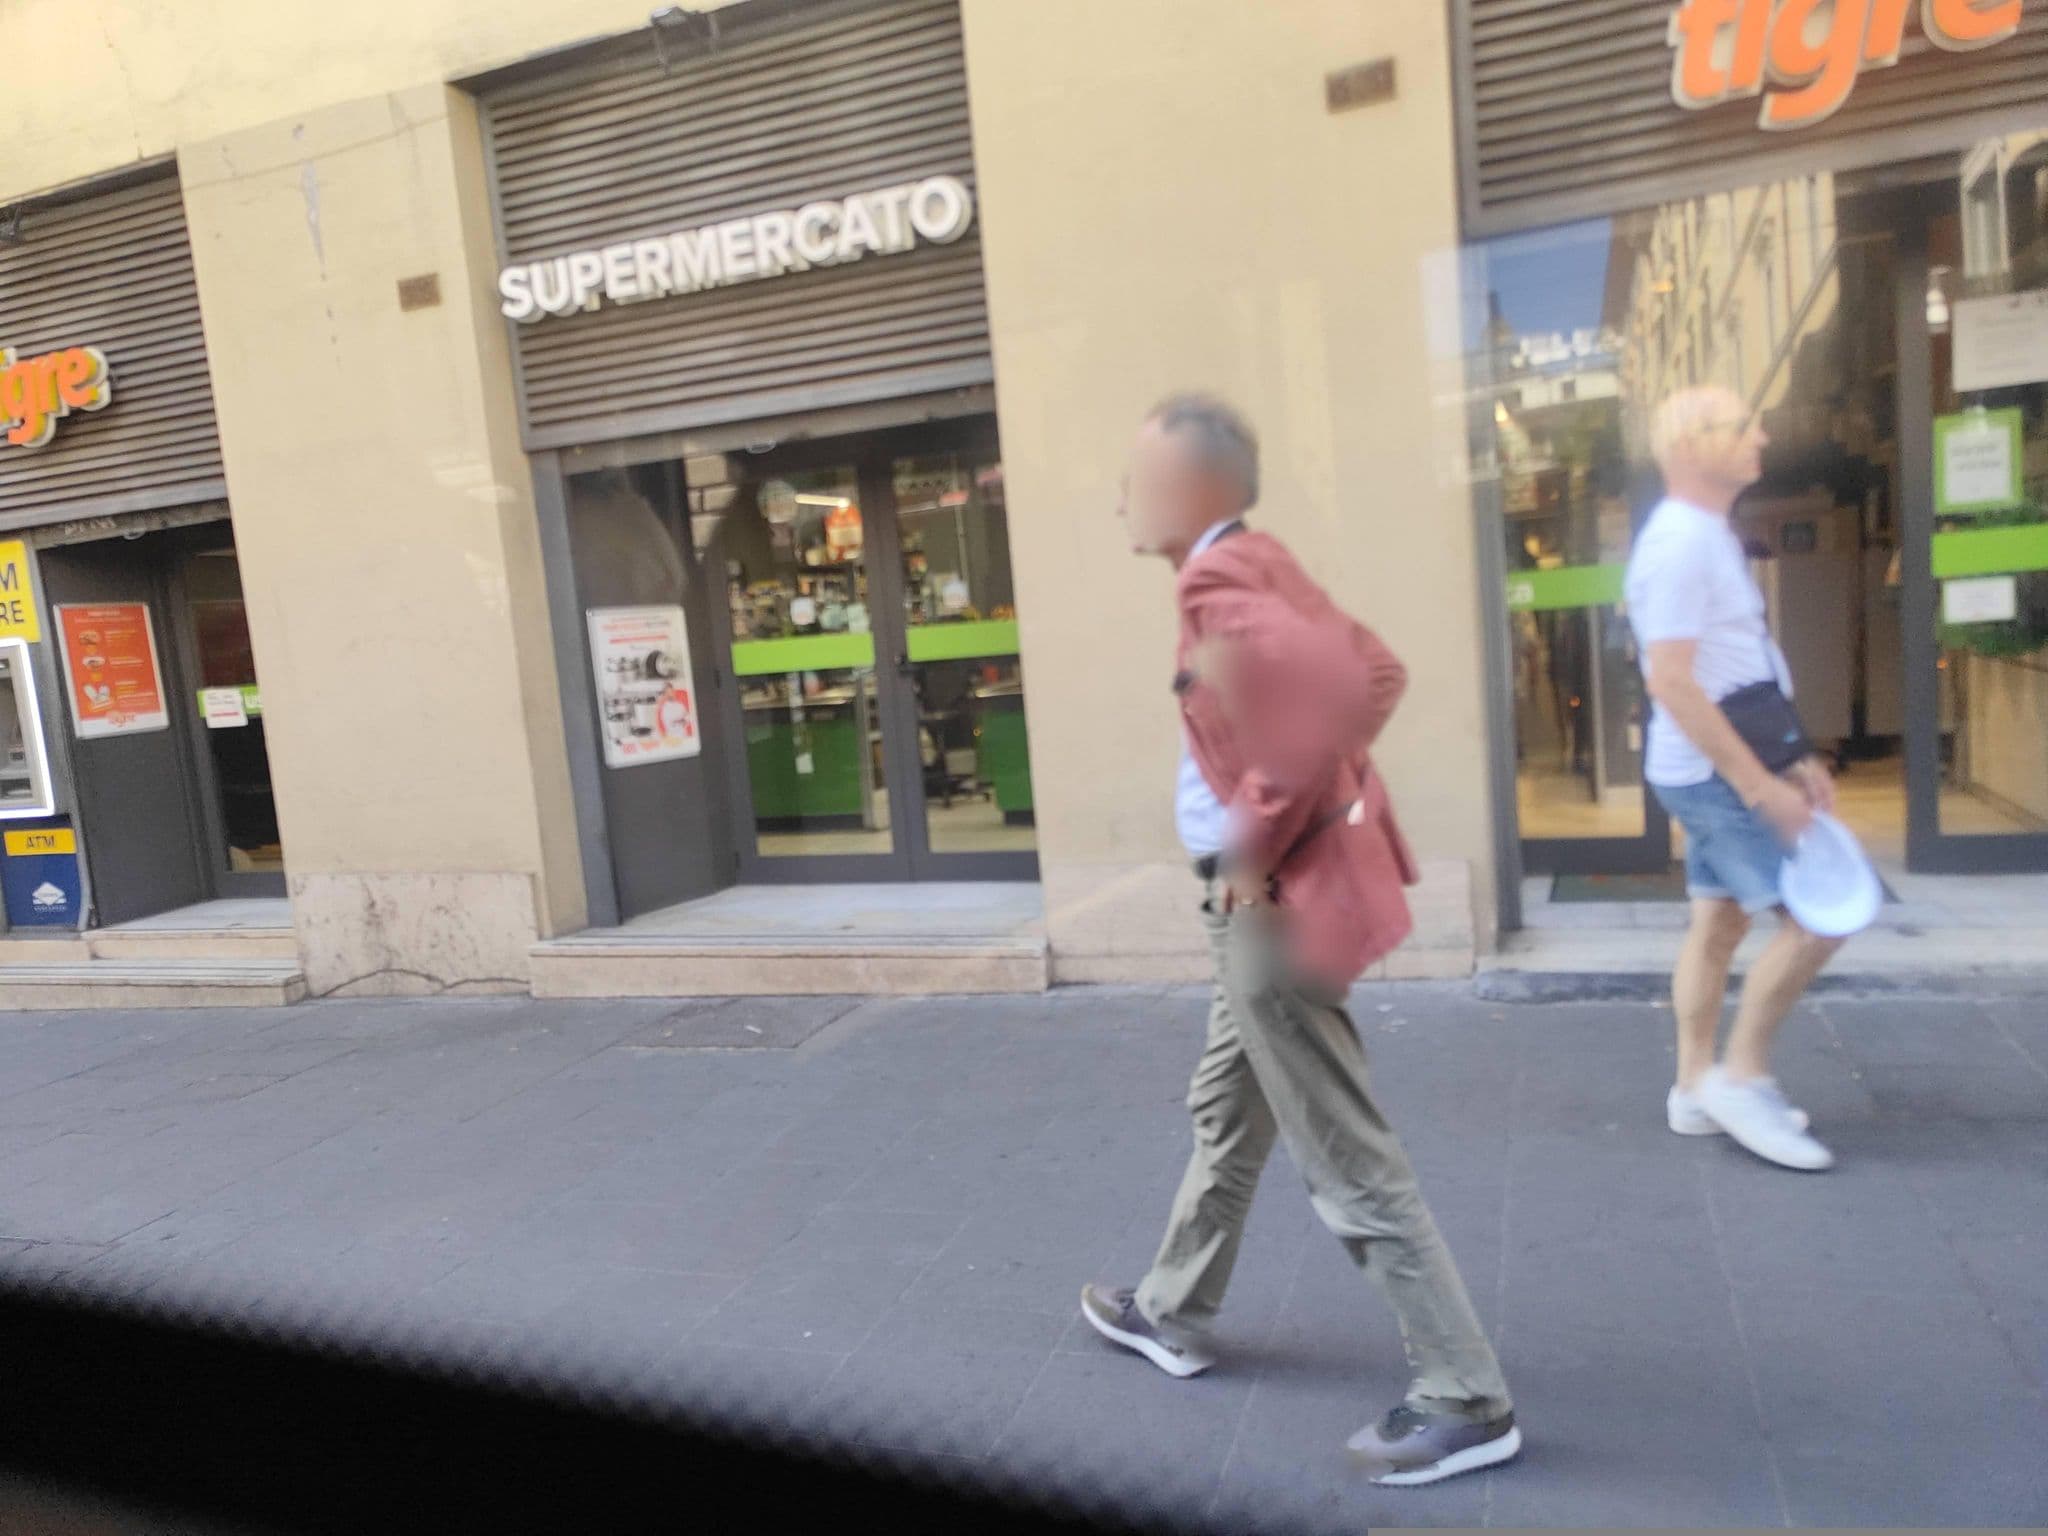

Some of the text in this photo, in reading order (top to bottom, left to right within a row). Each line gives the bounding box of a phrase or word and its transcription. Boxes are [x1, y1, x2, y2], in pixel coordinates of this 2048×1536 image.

[499, 175, 974, 323] SUPERMERCATO
[0, 346, 112, 448] gre
[26, 833, 56, 849] ATM
